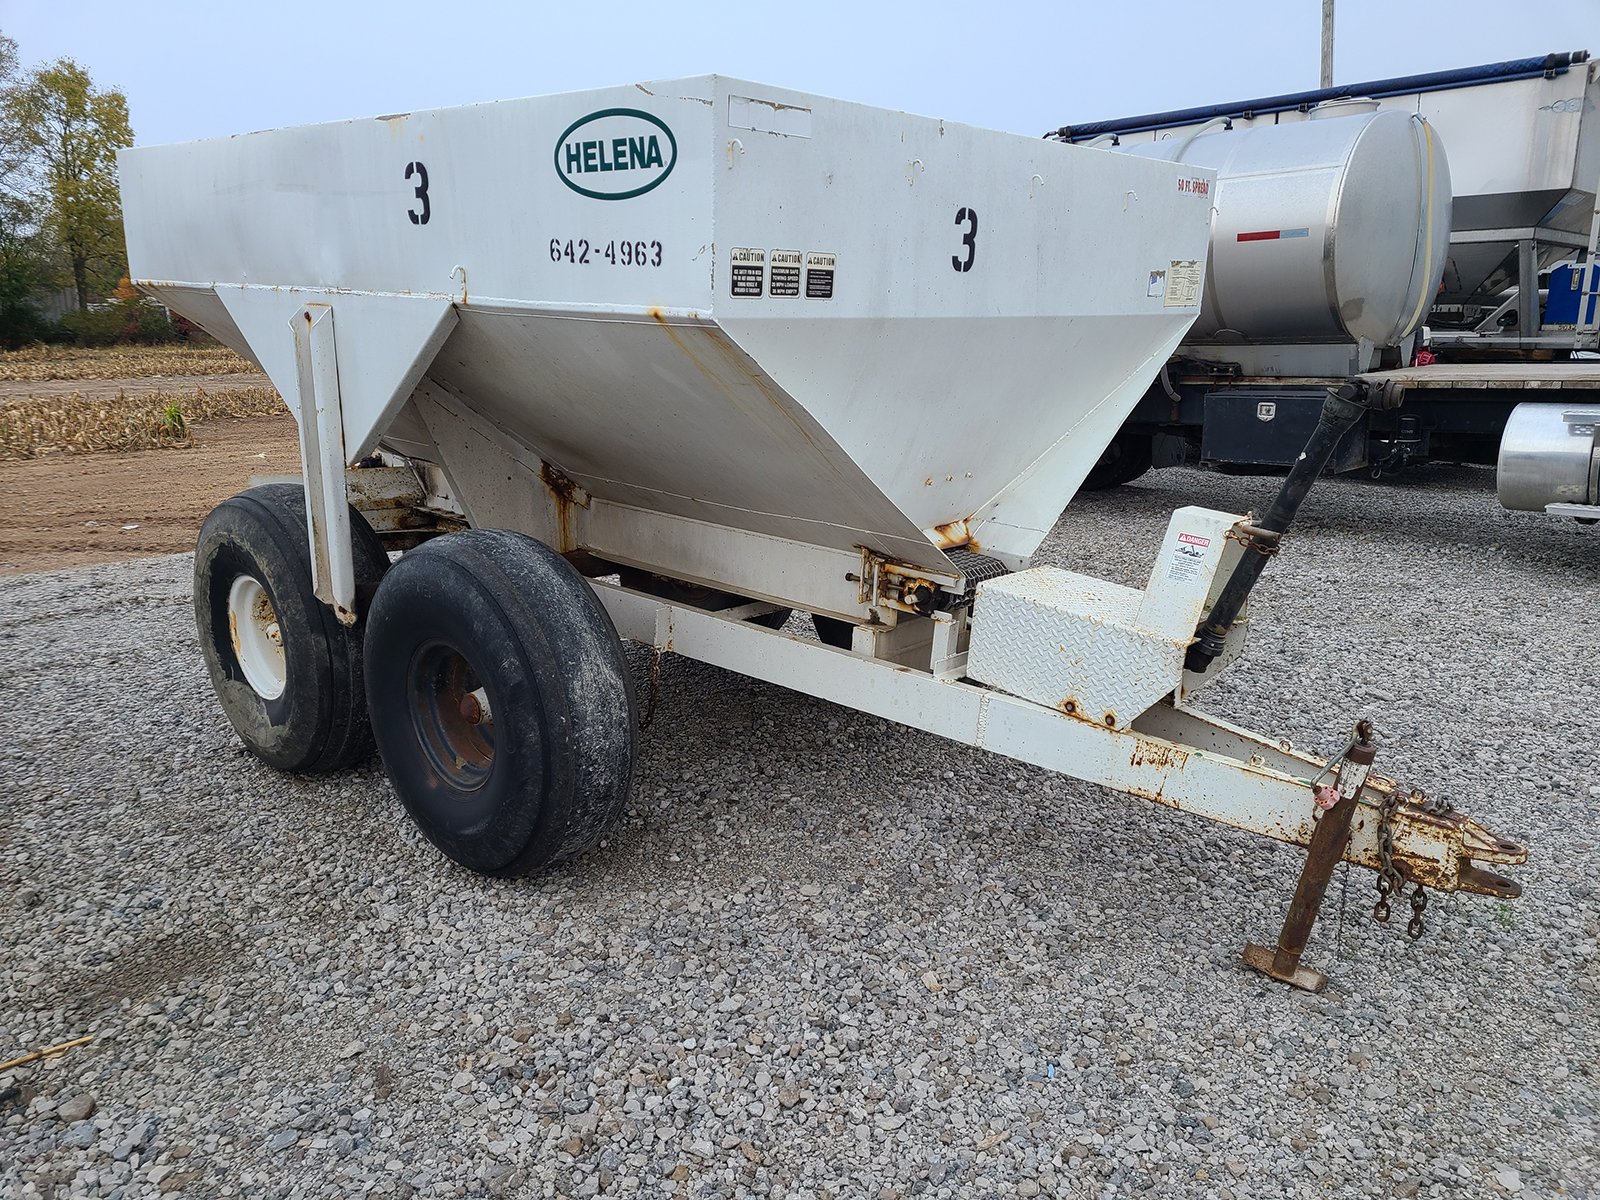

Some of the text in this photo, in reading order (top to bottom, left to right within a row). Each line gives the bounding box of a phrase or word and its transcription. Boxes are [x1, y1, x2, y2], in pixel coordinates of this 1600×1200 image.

[565, 134, 664, 174] HELENA
[404, 161, 431, 225] 3
[1178, 178, 1184, 191] 50
[1192, 181, 1209, 194] SPREAD
[951, 207, 978, 272] 3
[549, 238, 663, 268] 642-4963
[739, 252, 764, 262] CAUTION
[778, 254, 802, 263] CAUTION
[813, 257, 835, 266] CAUTION
[1186, 535, 1209, 546] DANGER
